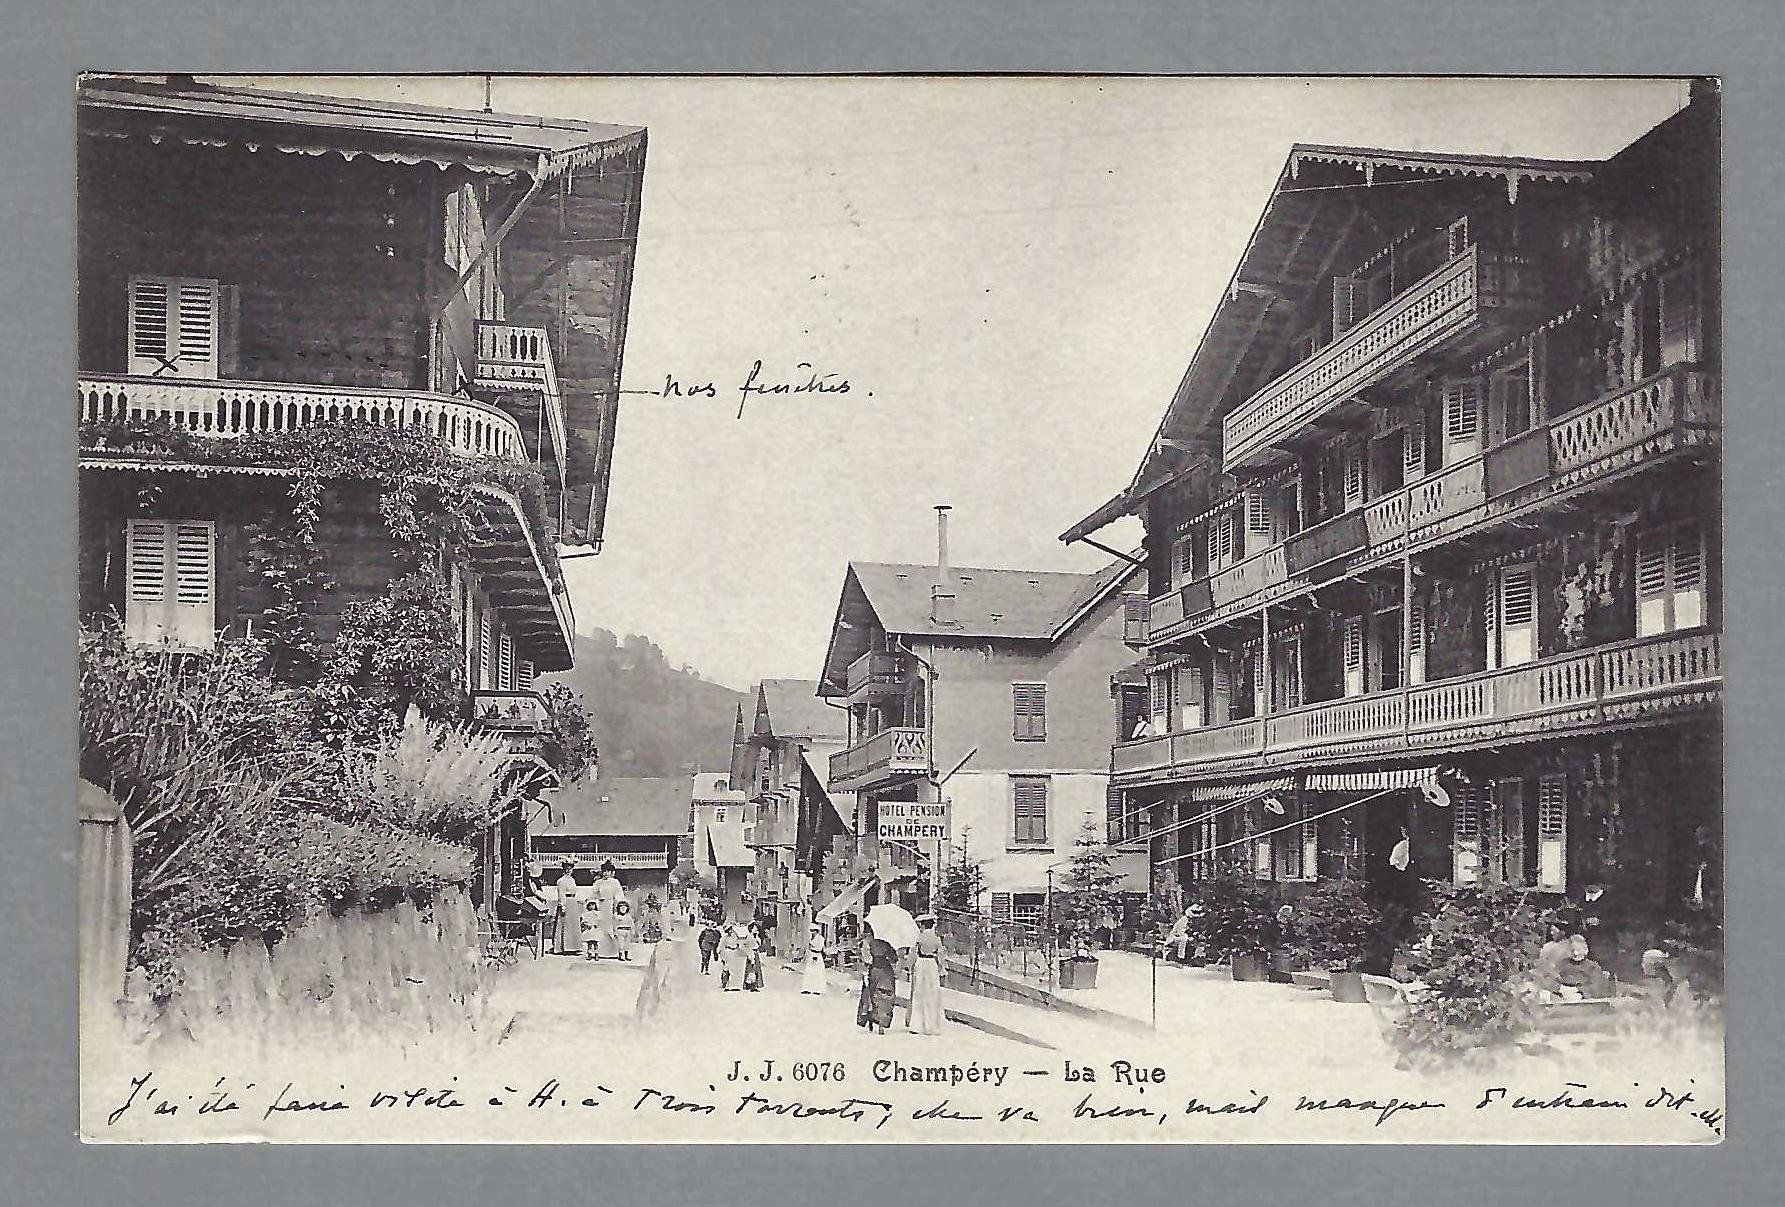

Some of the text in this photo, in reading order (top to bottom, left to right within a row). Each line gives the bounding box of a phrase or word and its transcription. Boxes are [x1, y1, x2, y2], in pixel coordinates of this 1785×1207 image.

[910, 805, 946, 817] PENSION
[107, 1071, 193, 1126] J'ai
[369, 1076, 465, 1109] visite
[488, 1086, 518, 1107] à
[581, 1085, 614, 1108] à
[912, 1099, 983, 1121] elle
[998, 1107, 1039, 1123] va
[1073, 1087, 1168, 1126] bien,
[1185, 1089, 1269, 1115] mais
